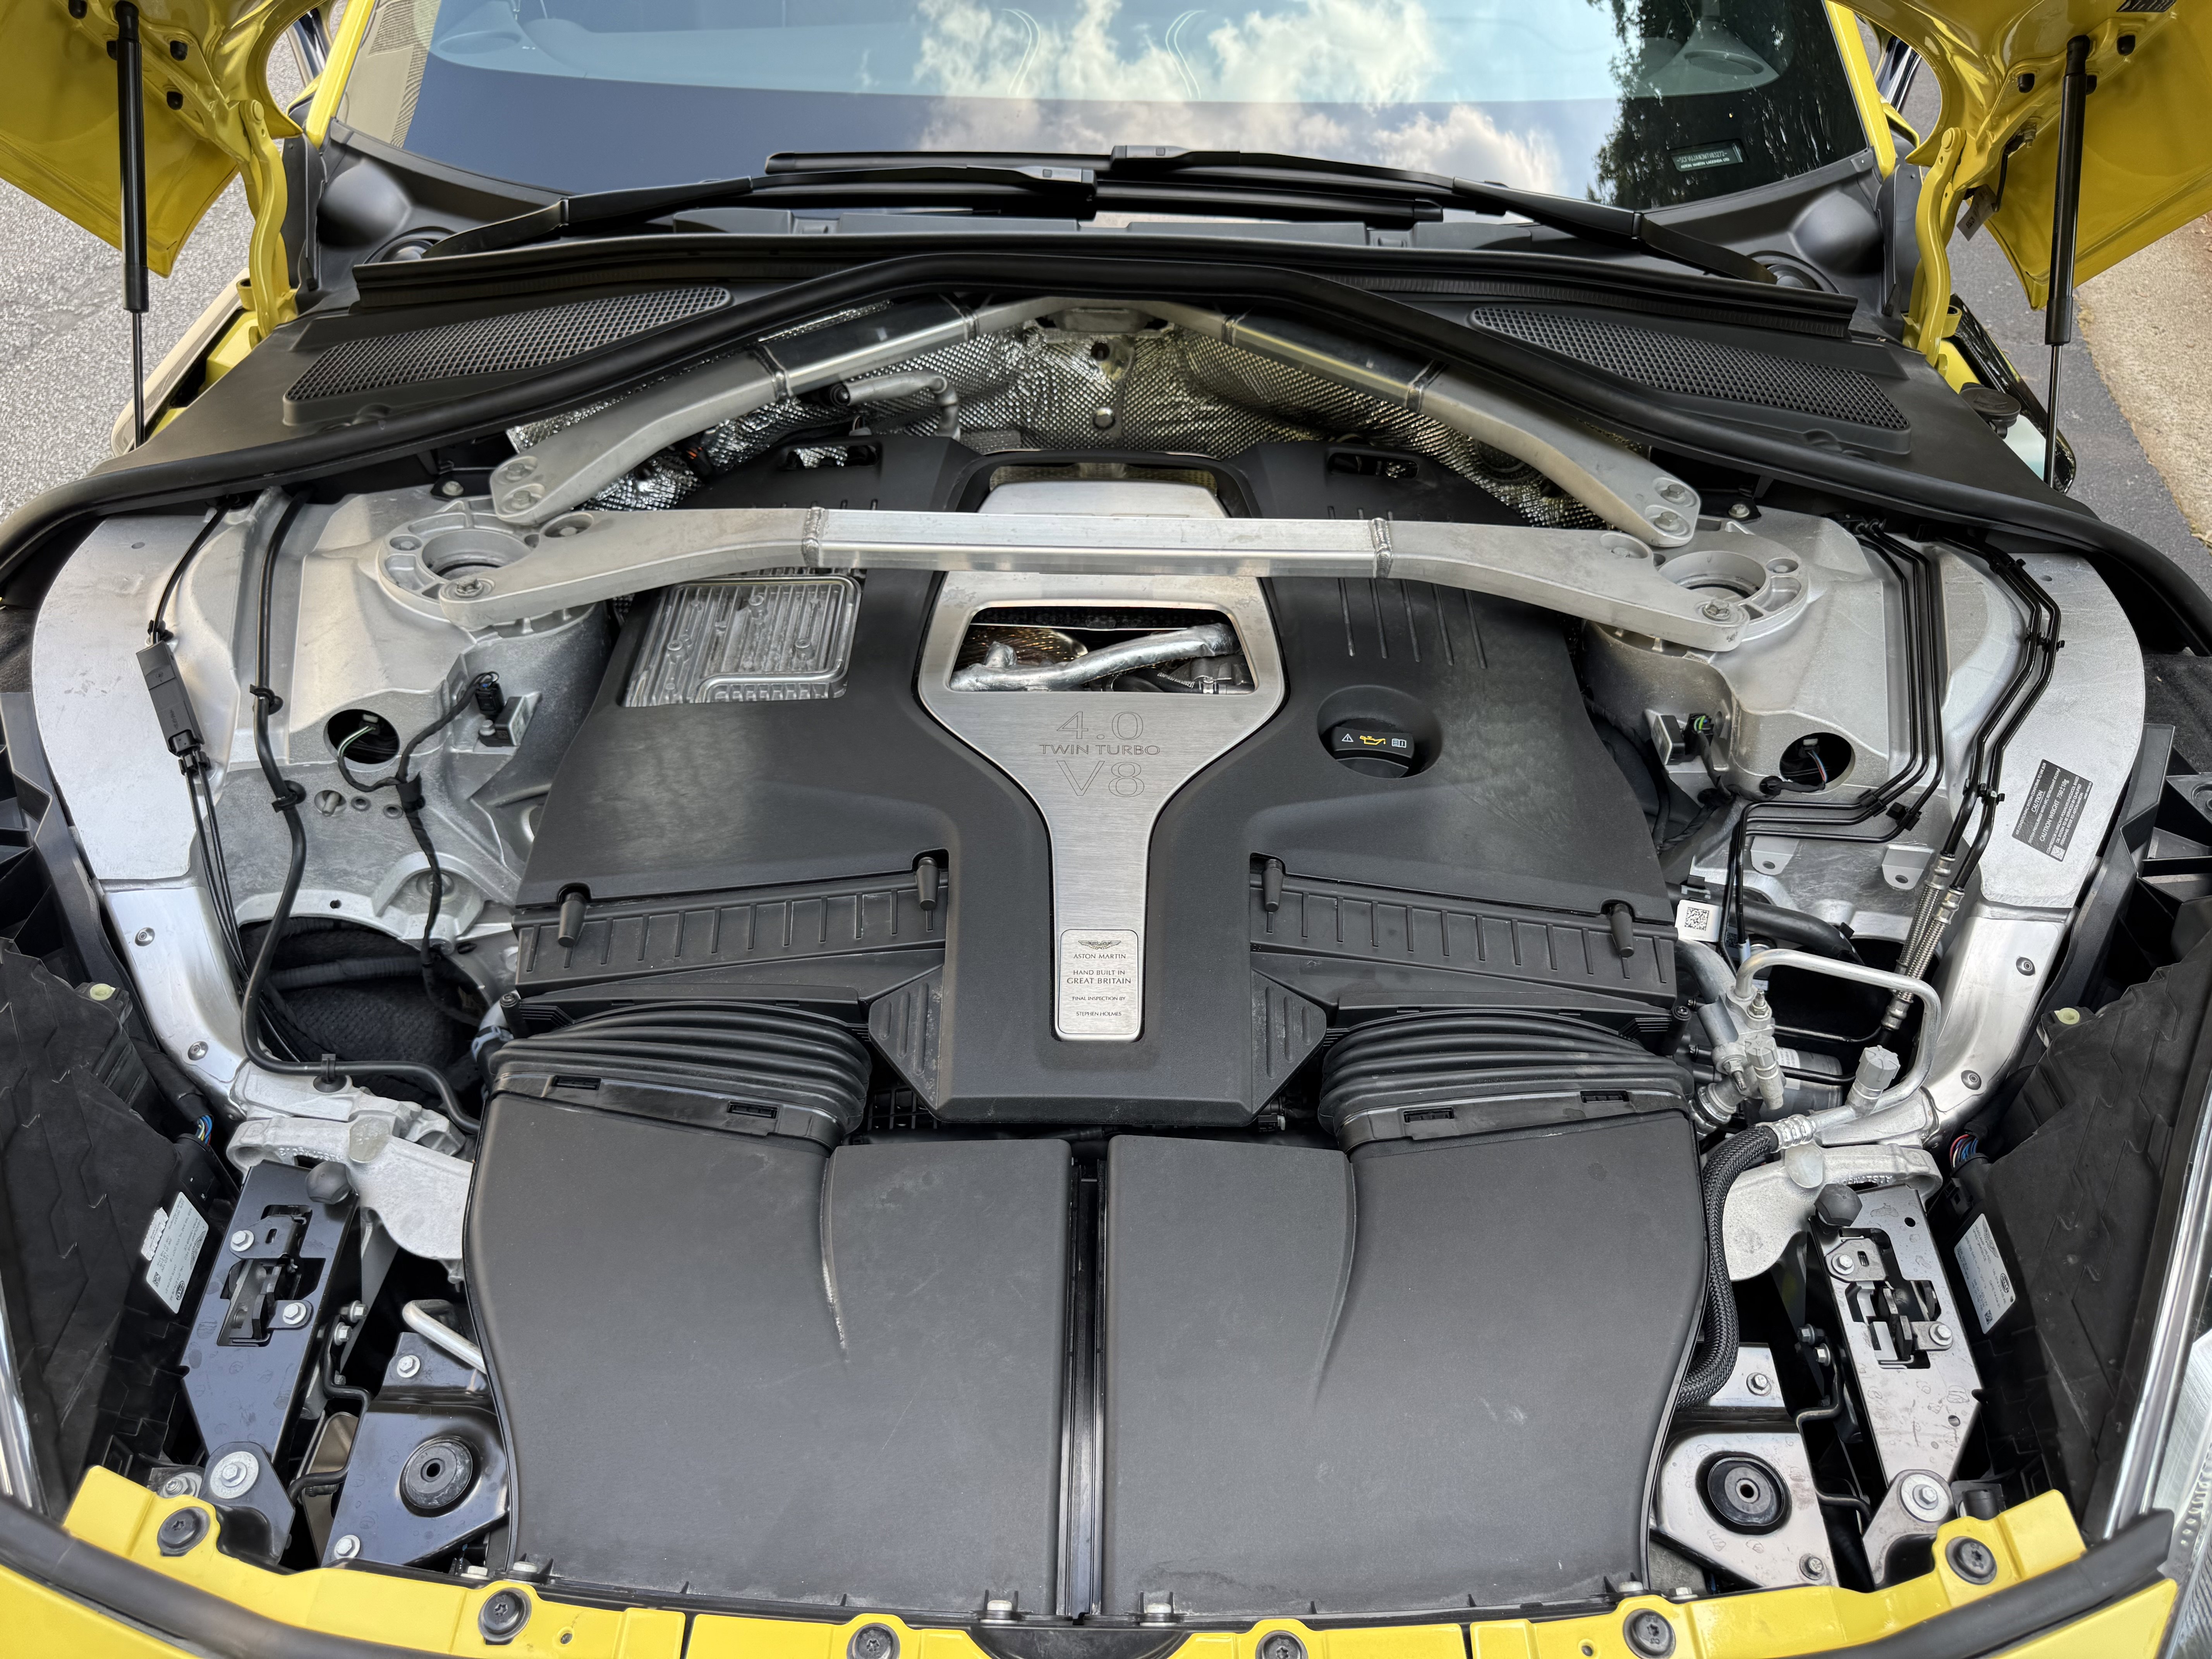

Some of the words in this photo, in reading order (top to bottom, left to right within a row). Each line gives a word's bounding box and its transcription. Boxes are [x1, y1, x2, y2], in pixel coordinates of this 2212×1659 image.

[1056, 711, 1144, 740] 4.0
[1039, 744, 1089, 754] TWIN
[1095, 745, 1160, 755] TURBO
[1056, 761, 1145, 797] V8
[2031, 790, 2043, 812] CAUTION
[2039, 818, 2052, 842] CAUTION
[2048, 799, 2059, 819] WEIGHT
